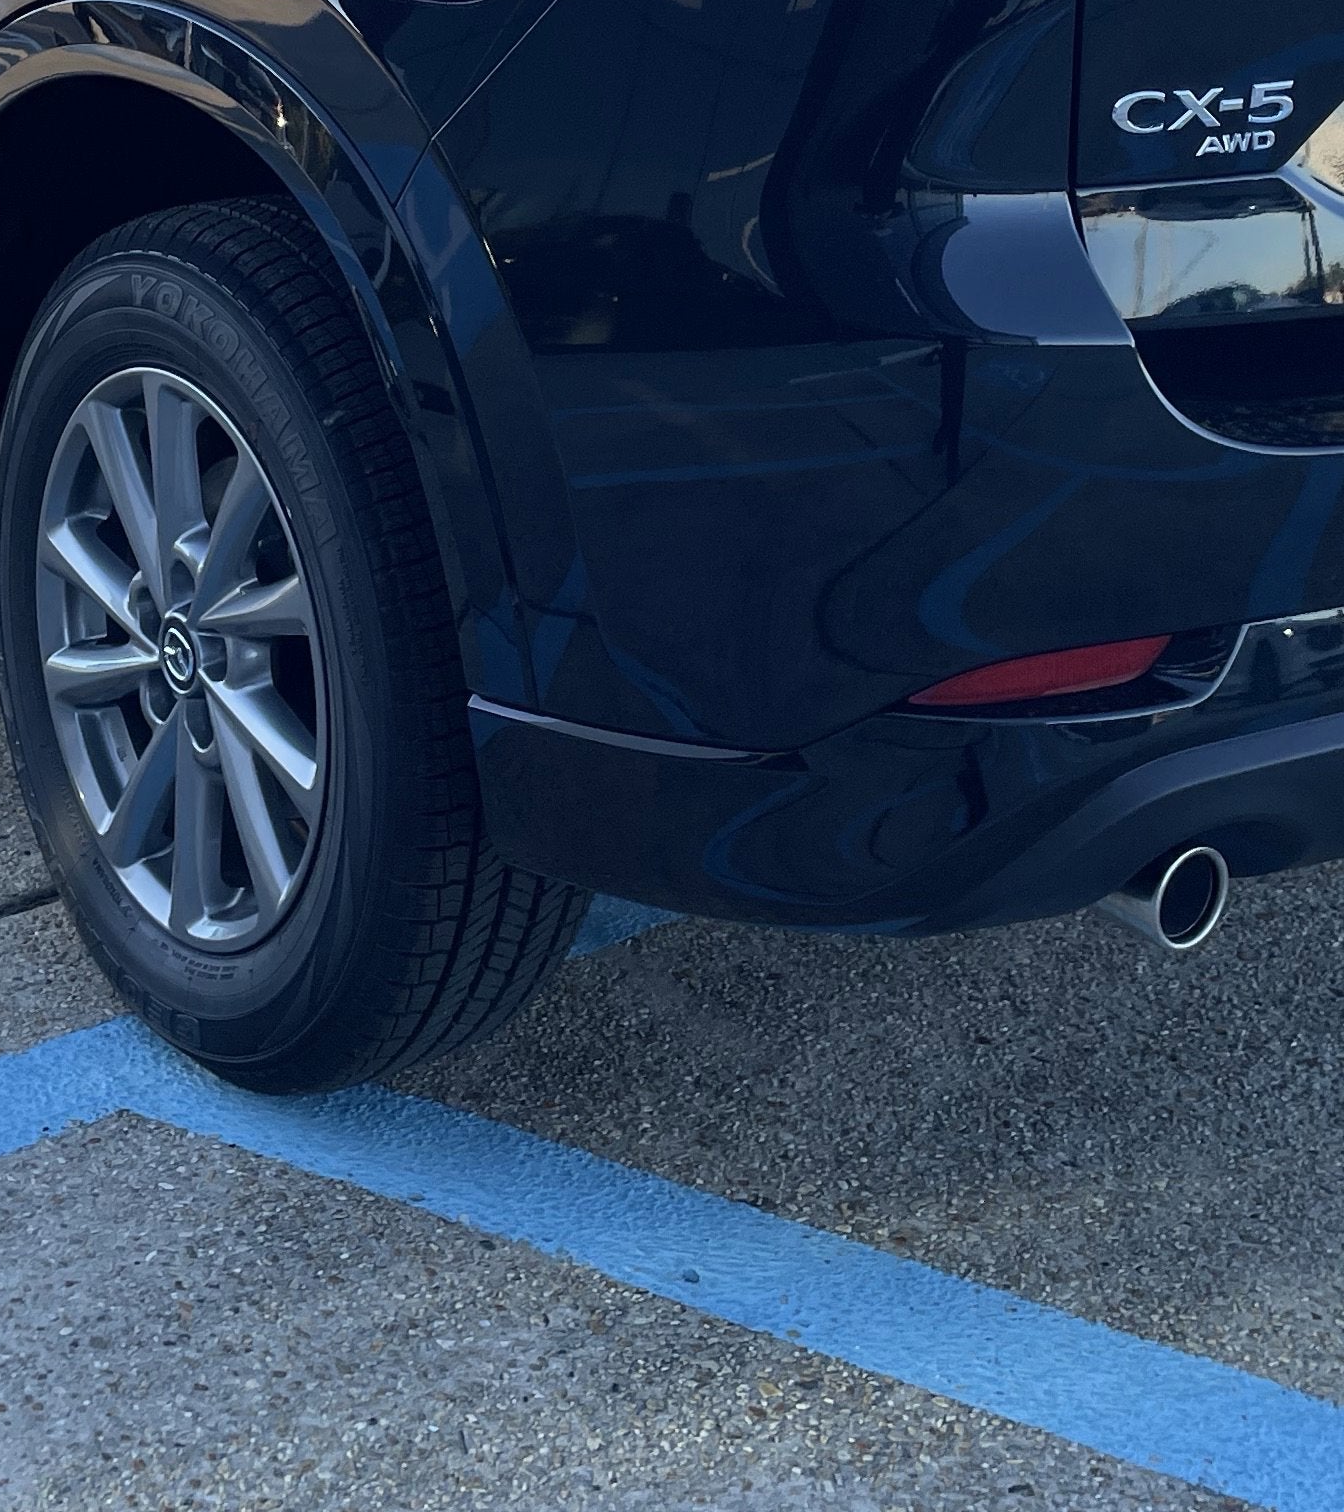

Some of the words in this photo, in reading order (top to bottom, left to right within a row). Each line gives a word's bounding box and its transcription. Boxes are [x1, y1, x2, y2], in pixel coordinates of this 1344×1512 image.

[1111, 80, 1295, 135] CX-5
[1195, 130, 1277, 157] AWD
[130, 273, 338, 548] YOKOHAMA
